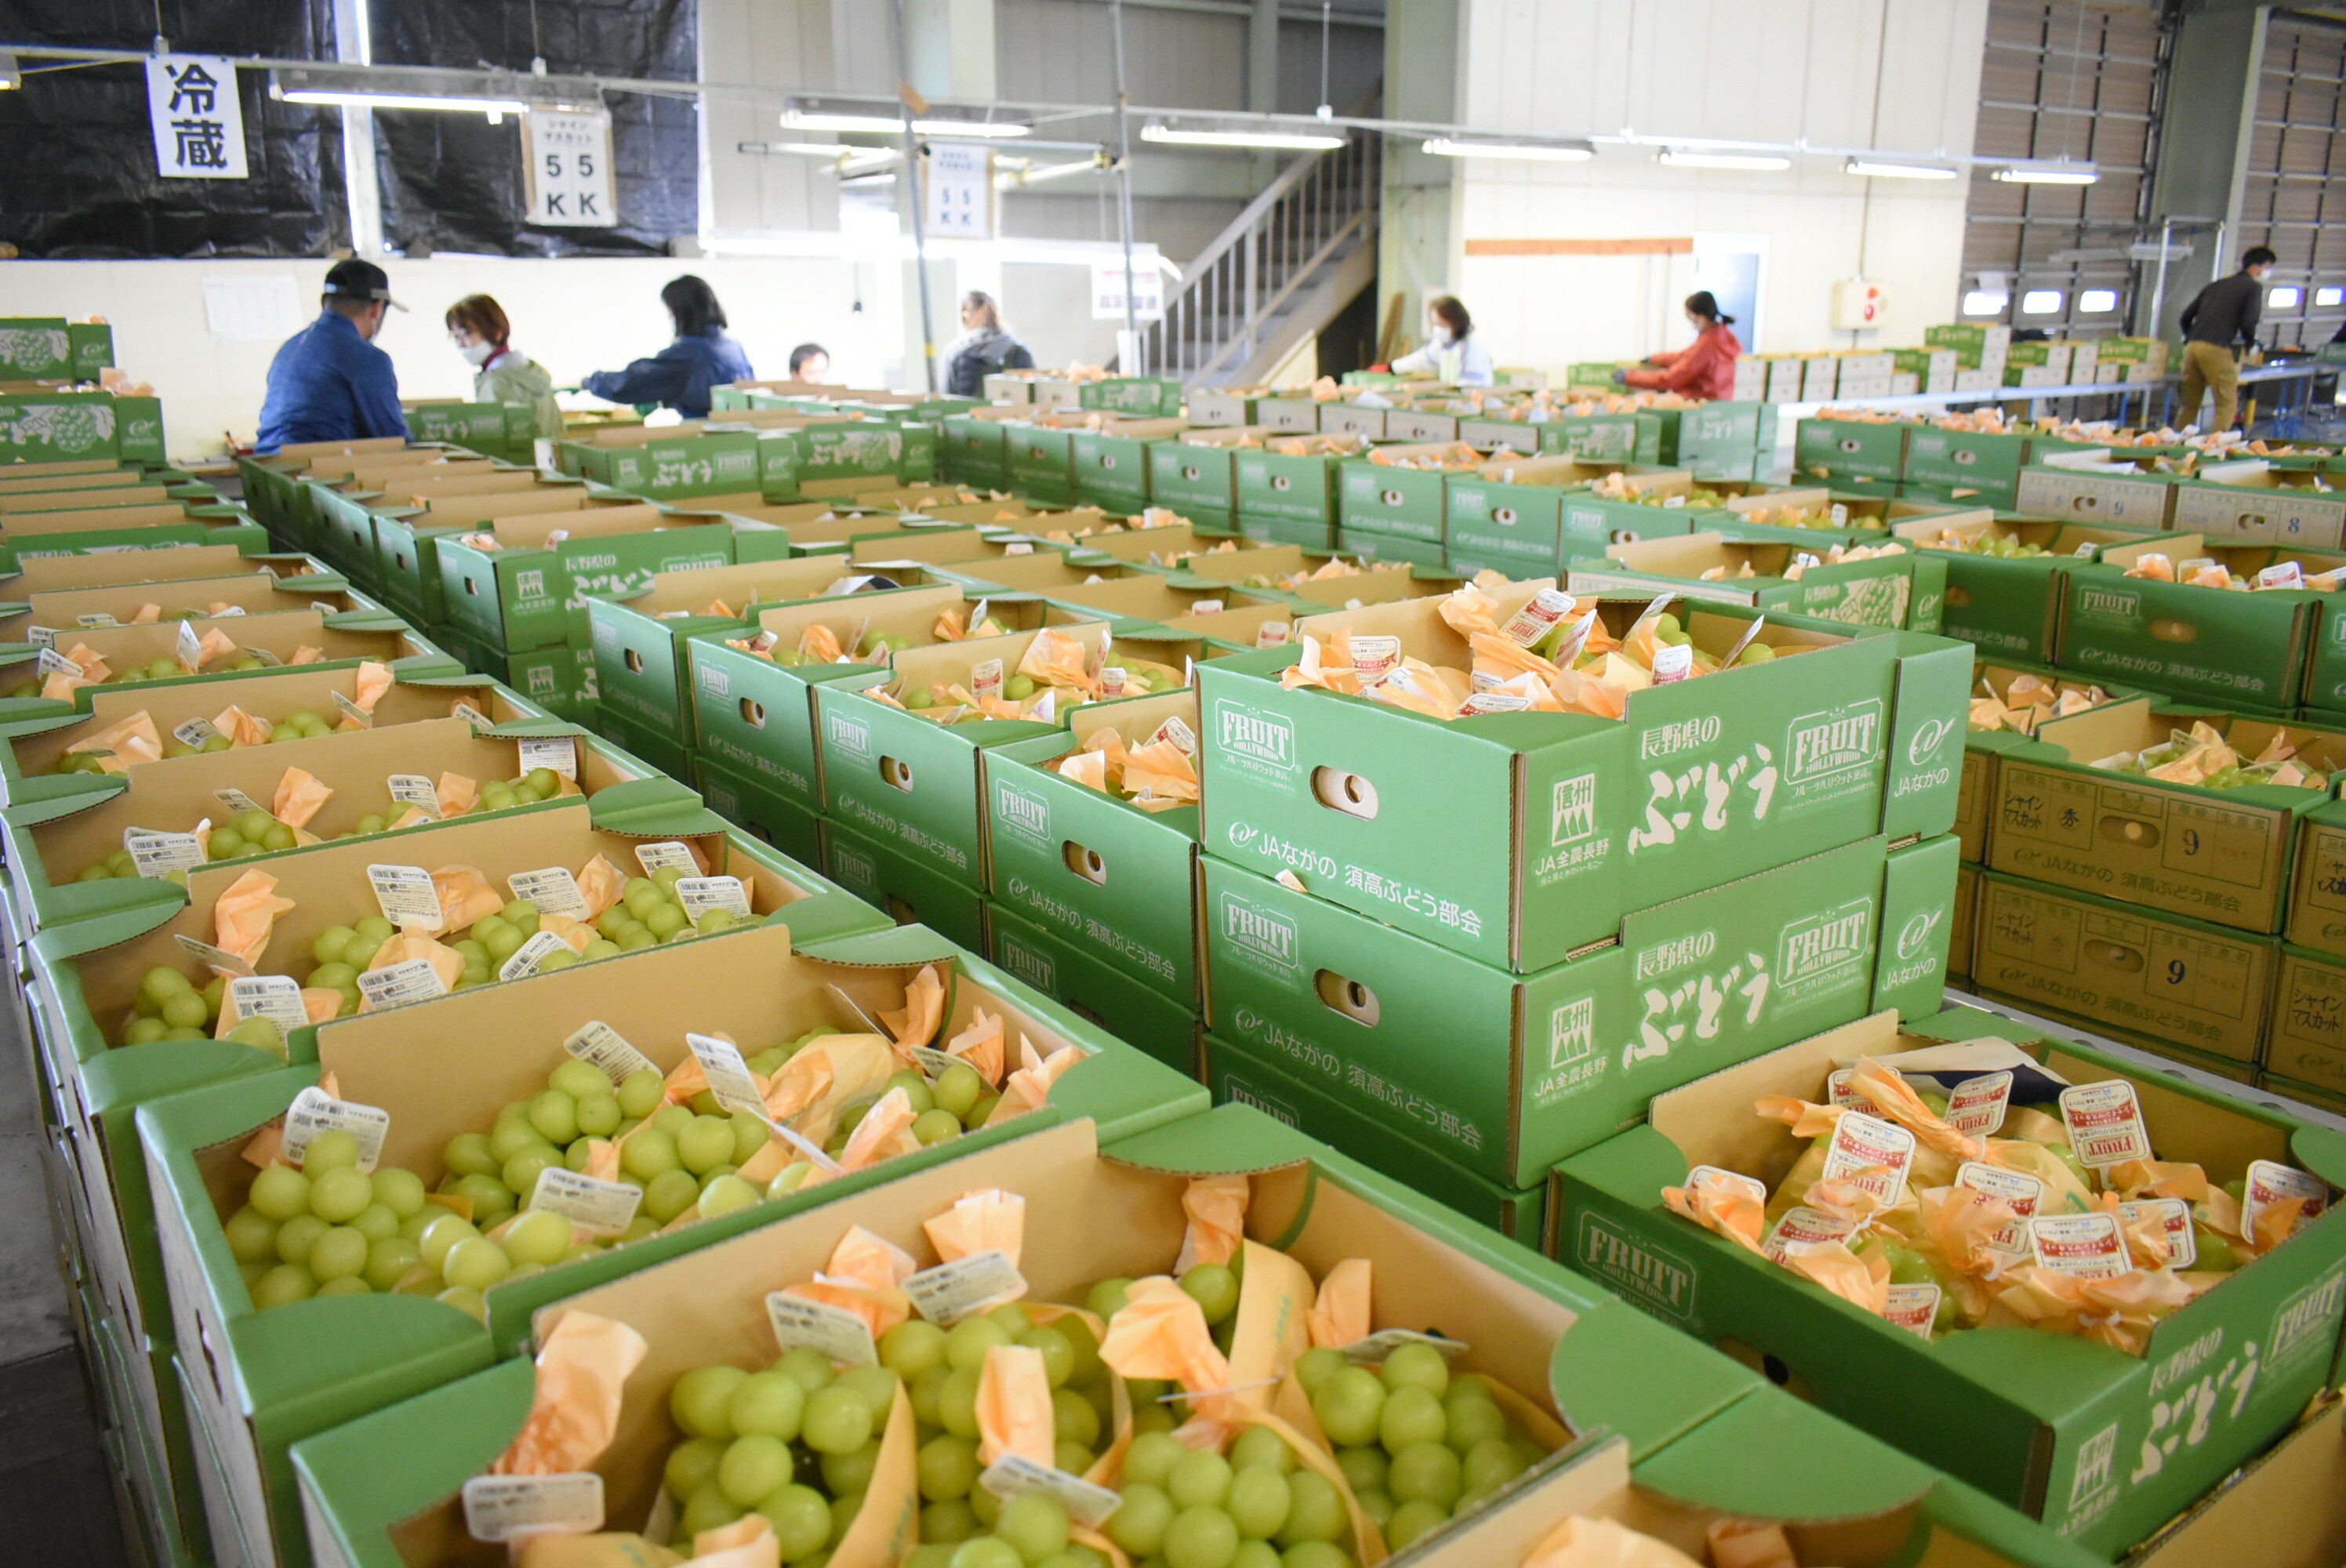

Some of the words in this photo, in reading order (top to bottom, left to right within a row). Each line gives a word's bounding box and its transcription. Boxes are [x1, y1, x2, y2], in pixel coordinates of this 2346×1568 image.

[165, 64, 227, 169] 冷蔵
[830, 716, 868, 753] FRUIT
[1222, 709, 1289, 760] FRUIT
[1641, 715, 1721, 760] 長野県の
[1792, 712, 1876, 778] FRUIT
[1556, 778, 1592, 813] 信州
[1628, 742, 1778, 856] ぶどう
[1894, 767, 1950, 797] JAながの
[855, 802, 897, 834] JAながの
[1000, 787, 1047, 833] FRUIT
[1535, 837, 1610, 876] JA全農長野
[1258, 833, 1338, 880] JAながの
[1344, 863, 1482, 938] 須高ぶどう部会
[2042, 857, 2114, 883] JAながの
[2121, 871, 2241, 913] 須高ぶどう部会
[1029, 889, 1082, 930] JAながの
[1086, 917, 1176, 983] 須高ぶどう部会
[1227, 903, 1292, 960] FRUIT
[1637, 931, 1716, 981] 長野県の
[1784, 911, 1866, 981] FRUIT
[1006, 941, 1051, 990] FRUIT
[1883, 957, 1937, 991] JAながの
[2166, 959, 2186, 985] 9
[1622, 953, 1770, 1071] ぶどう
[2026, 976, 2099, 1006] JAながの
[1264, 1024, 1341, 1076] JAながの
[1348, 1064, 1482, 1152] 須高ぶどう部会
[1534, 1055, 1607, 1098] JA全農長野
[2072, 1107, 2131, 1122] シャインマスカット
[2087, 1135, 2133, 1156] FRUIT
[1838, 1167, 1887, 1196] FRUT
[1588, 1225, 1688, 1307] FRUIT
[2130, 1340, 2258, 1485] ぶどう
